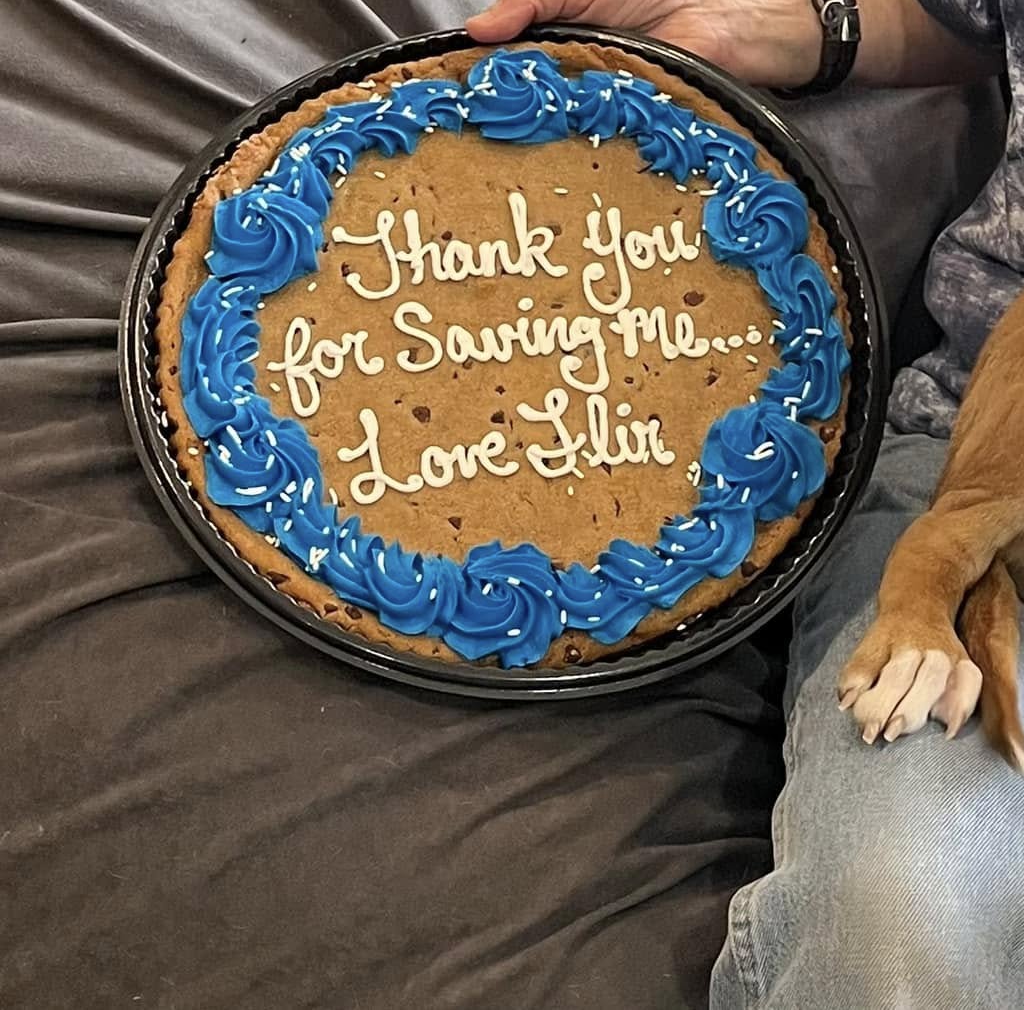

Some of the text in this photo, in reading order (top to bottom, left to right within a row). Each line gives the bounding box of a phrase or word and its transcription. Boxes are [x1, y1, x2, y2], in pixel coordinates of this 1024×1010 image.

[332, 192, 568, 299] Thank
[267, 316, 385, 418] for
[393, 296, 610, 393] Saving
[337, 407, 520, 504] Love
